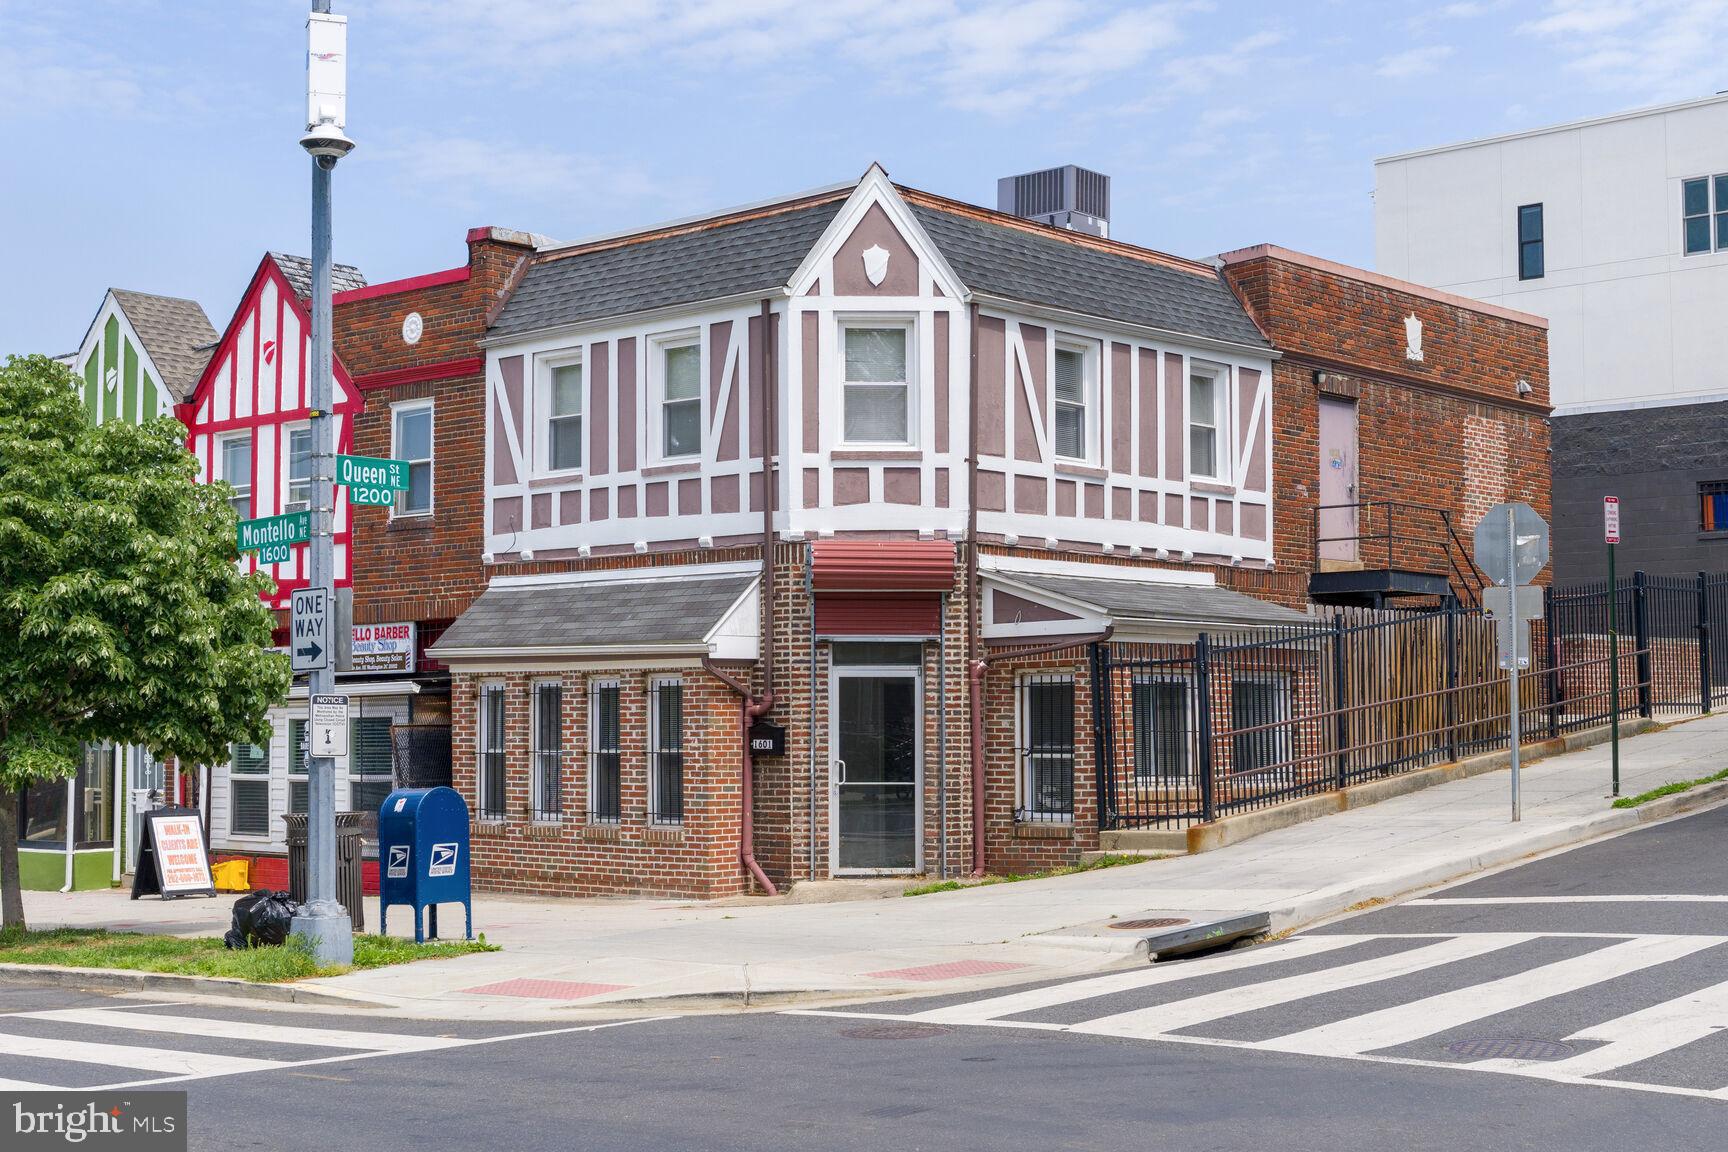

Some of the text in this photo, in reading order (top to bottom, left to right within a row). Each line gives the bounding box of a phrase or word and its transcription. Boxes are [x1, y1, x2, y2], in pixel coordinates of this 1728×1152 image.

[343, 459, 400, 485] Queen St
[390, 476, 400, 487] NE
[353, 487, 392, 504] 1200
[243, 514, 308, 547] Montello Ave
[299, 527, 307, 539] NE
[262, 545, 288, 562] 1600
[296, 595, 323, 615] ONE
[295, 617, 324, 638] WAY
[374, 625, 410, 640] BARBER
[377, 638, 397, 653] Shop
[316, 696, 344, 704] NOTICE
[754, 740, 772, 749] 1601
[163, 823, 191, 835] WALK-IN
[161, 838, 199, 851] CLIENTS ARE
[167, 853, 197, 866] WELCOME
